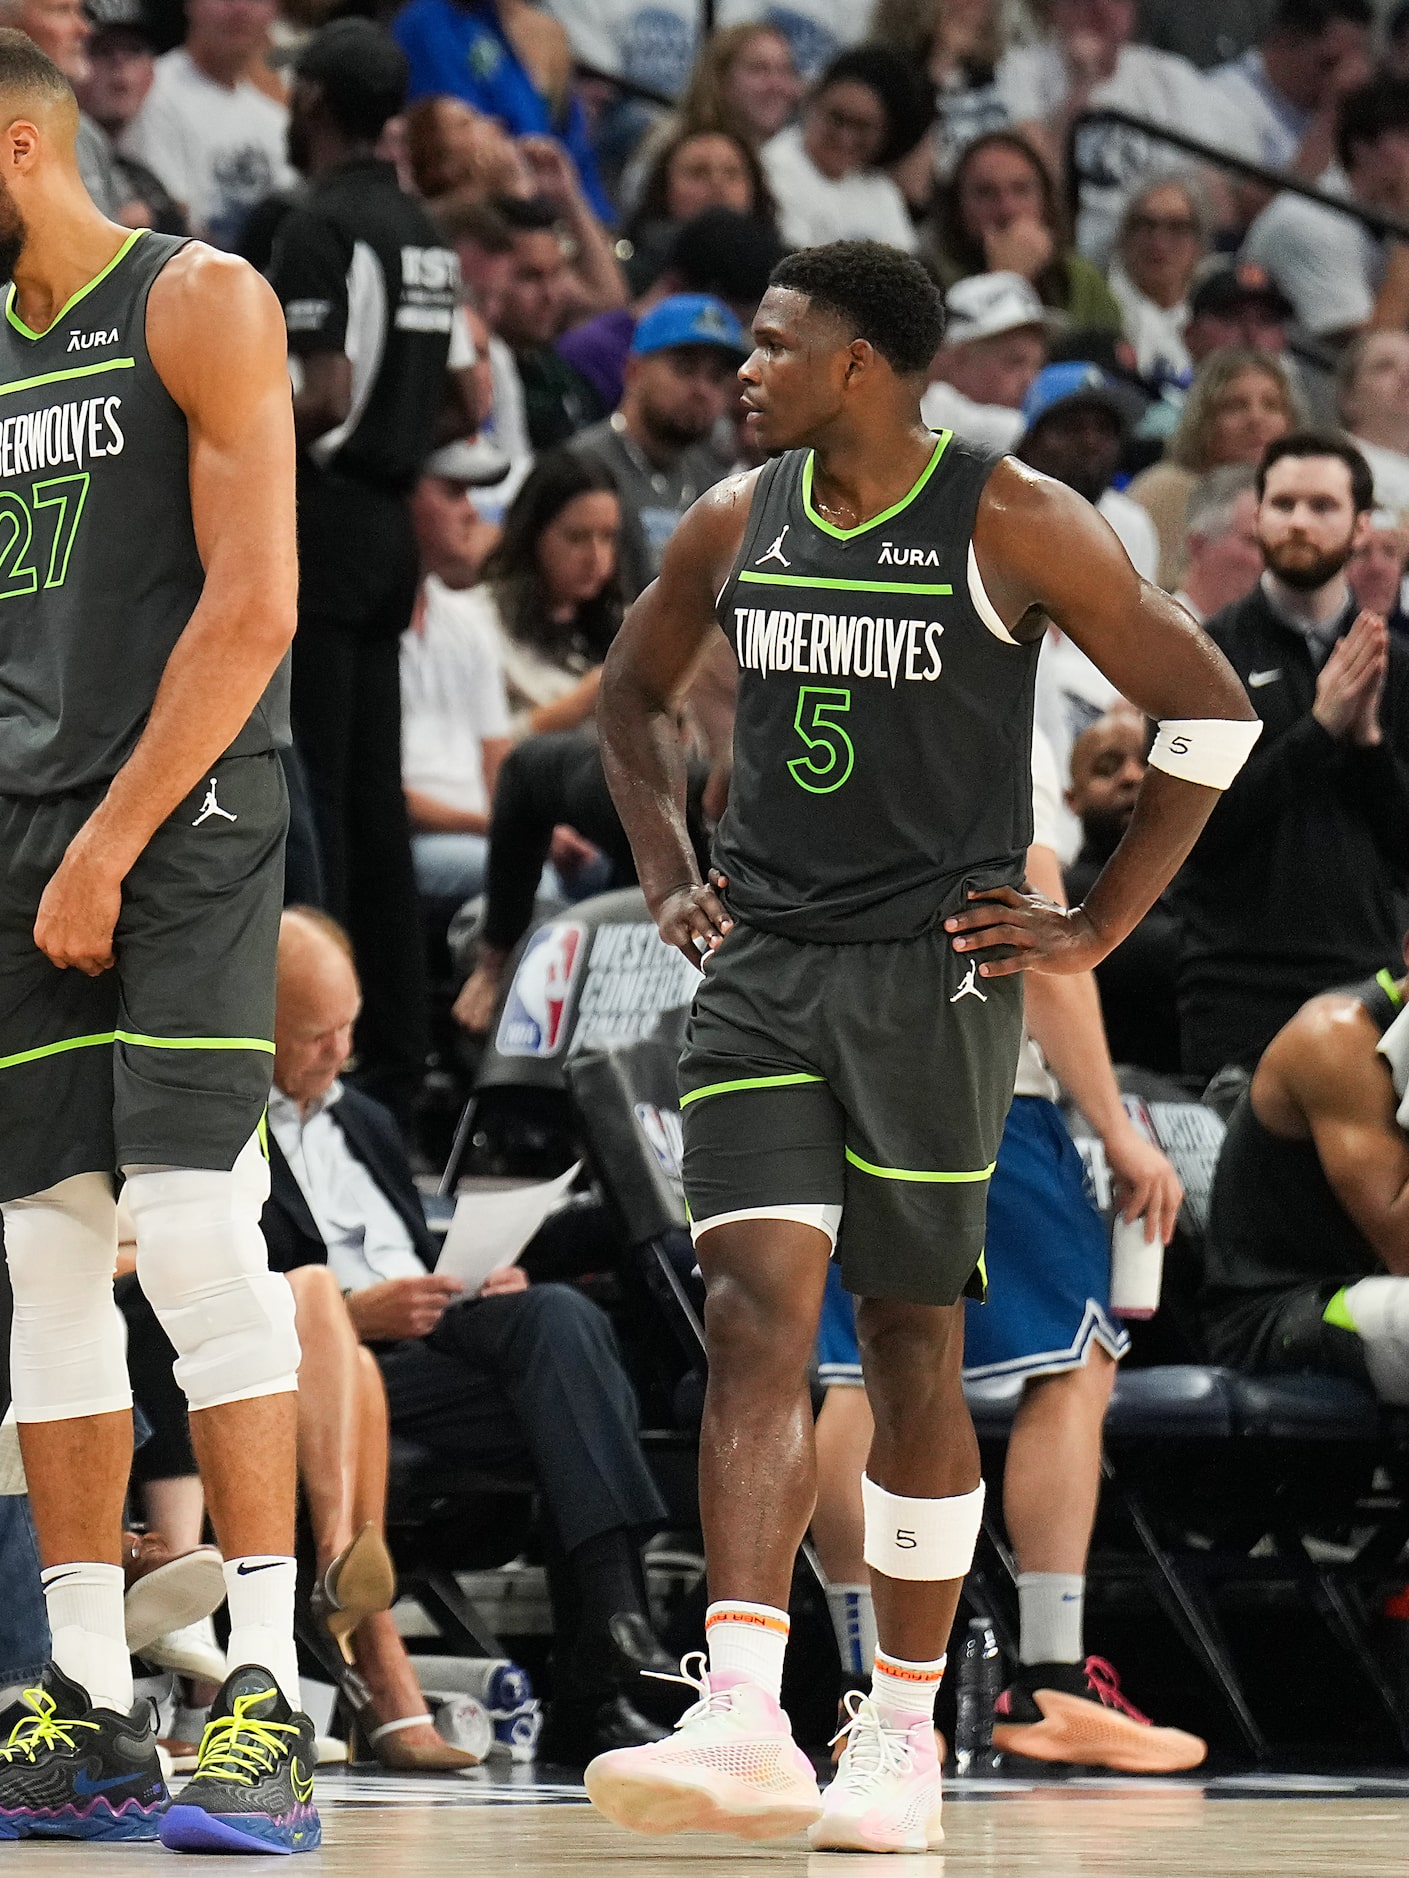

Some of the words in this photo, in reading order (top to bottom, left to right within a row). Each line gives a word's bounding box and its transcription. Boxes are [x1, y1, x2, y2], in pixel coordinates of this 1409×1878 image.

[734, 607, 945, 689] TIMBERWOLVES
[786, 685, 855, 794] 5
[1169, 736, 1192, 755] 5
[895, 1529, 917, 1549] 5
